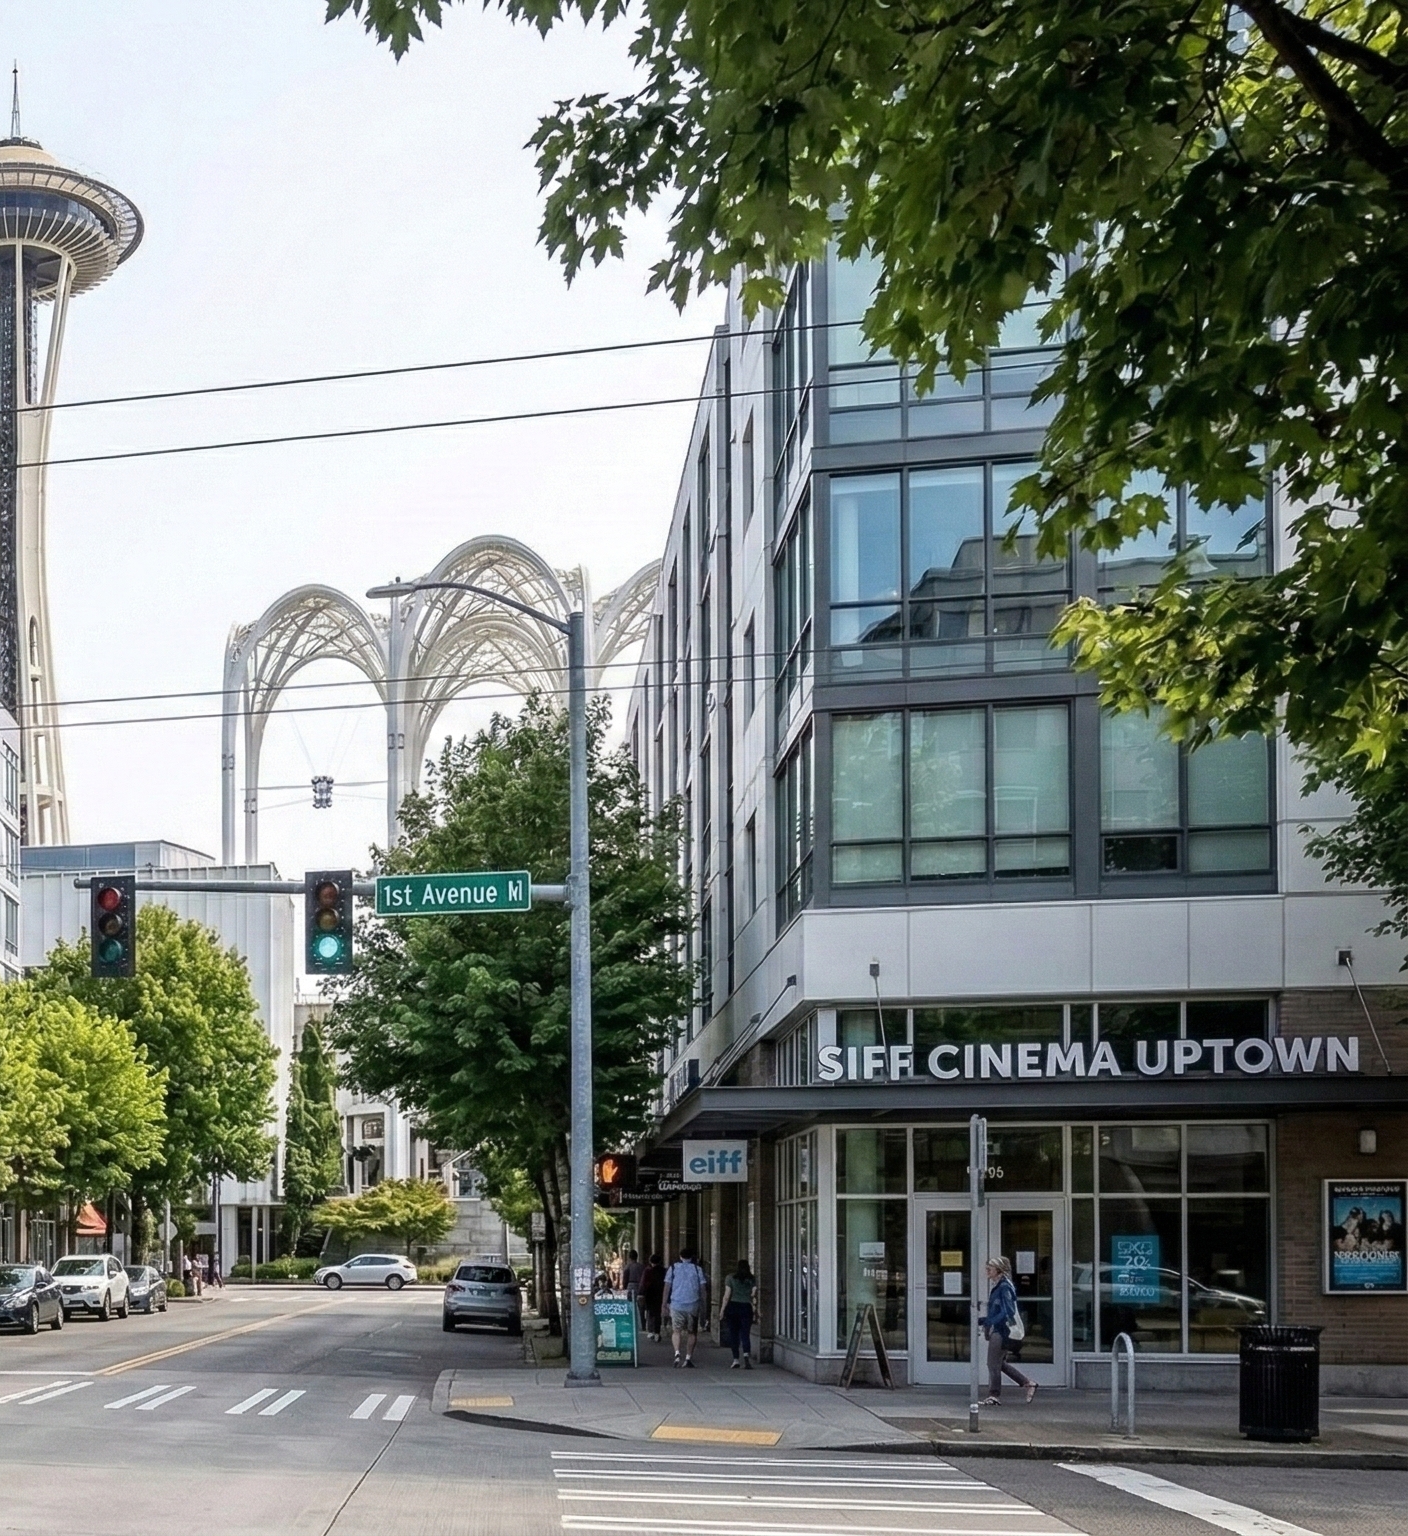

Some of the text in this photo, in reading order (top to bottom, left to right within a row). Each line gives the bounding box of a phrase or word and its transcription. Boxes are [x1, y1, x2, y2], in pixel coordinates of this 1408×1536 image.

[384, 884, 412, 906] 1st
[422, 883, 497, 905] Avenue
[819, 1036, 1359, 1081] SIFF CINEMA UPTOWN
[689, 1150, 742, 1174] eiff
